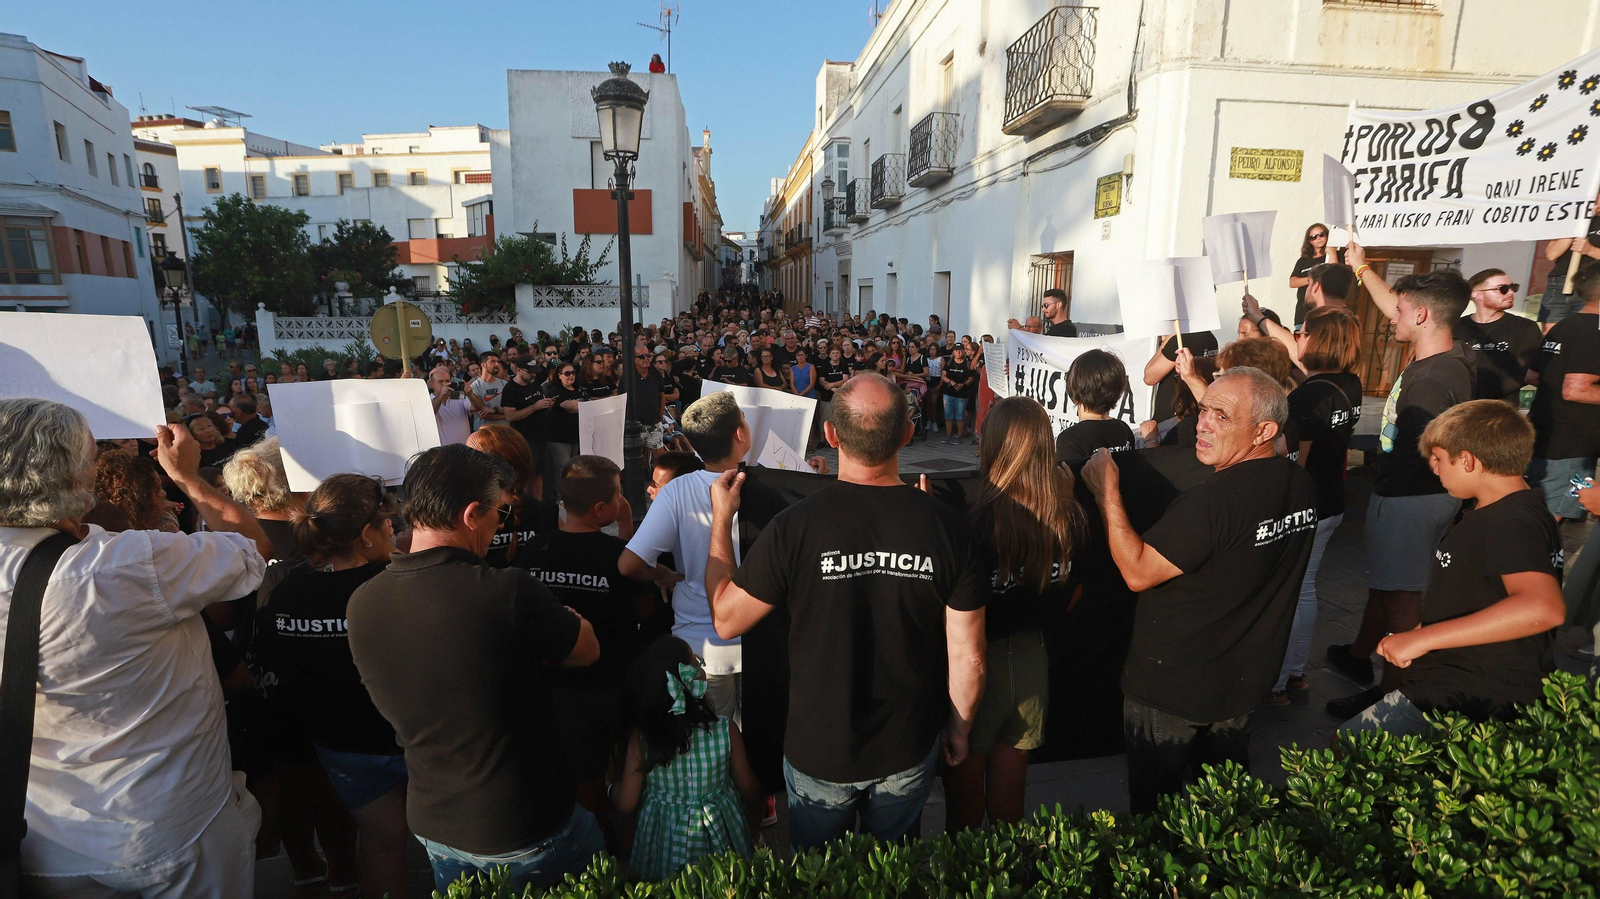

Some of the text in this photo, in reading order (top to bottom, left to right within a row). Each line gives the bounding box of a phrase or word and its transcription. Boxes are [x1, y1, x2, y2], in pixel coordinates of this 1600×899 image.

[1237, 157, 1296, 171] PEDRO ALFONSO
[1354, 157, 1470, 204] ETARIFA
[1485, 168, 1584, 199] DANI IRENE
[1360, 212, 1389, 229] MARI
[1392, 212, 1432, 228] KISKO
[1435, 208, 1475, 227] FRAN
[1483, 205, 1540, 223] COBITO
[486, 388, 499, 396] NIKE
[1015, 364, 1136, 424] #JUSTA
[821, 551, 934, 573] #JUSTICIA
[887, 569, 918, 579] transformador
